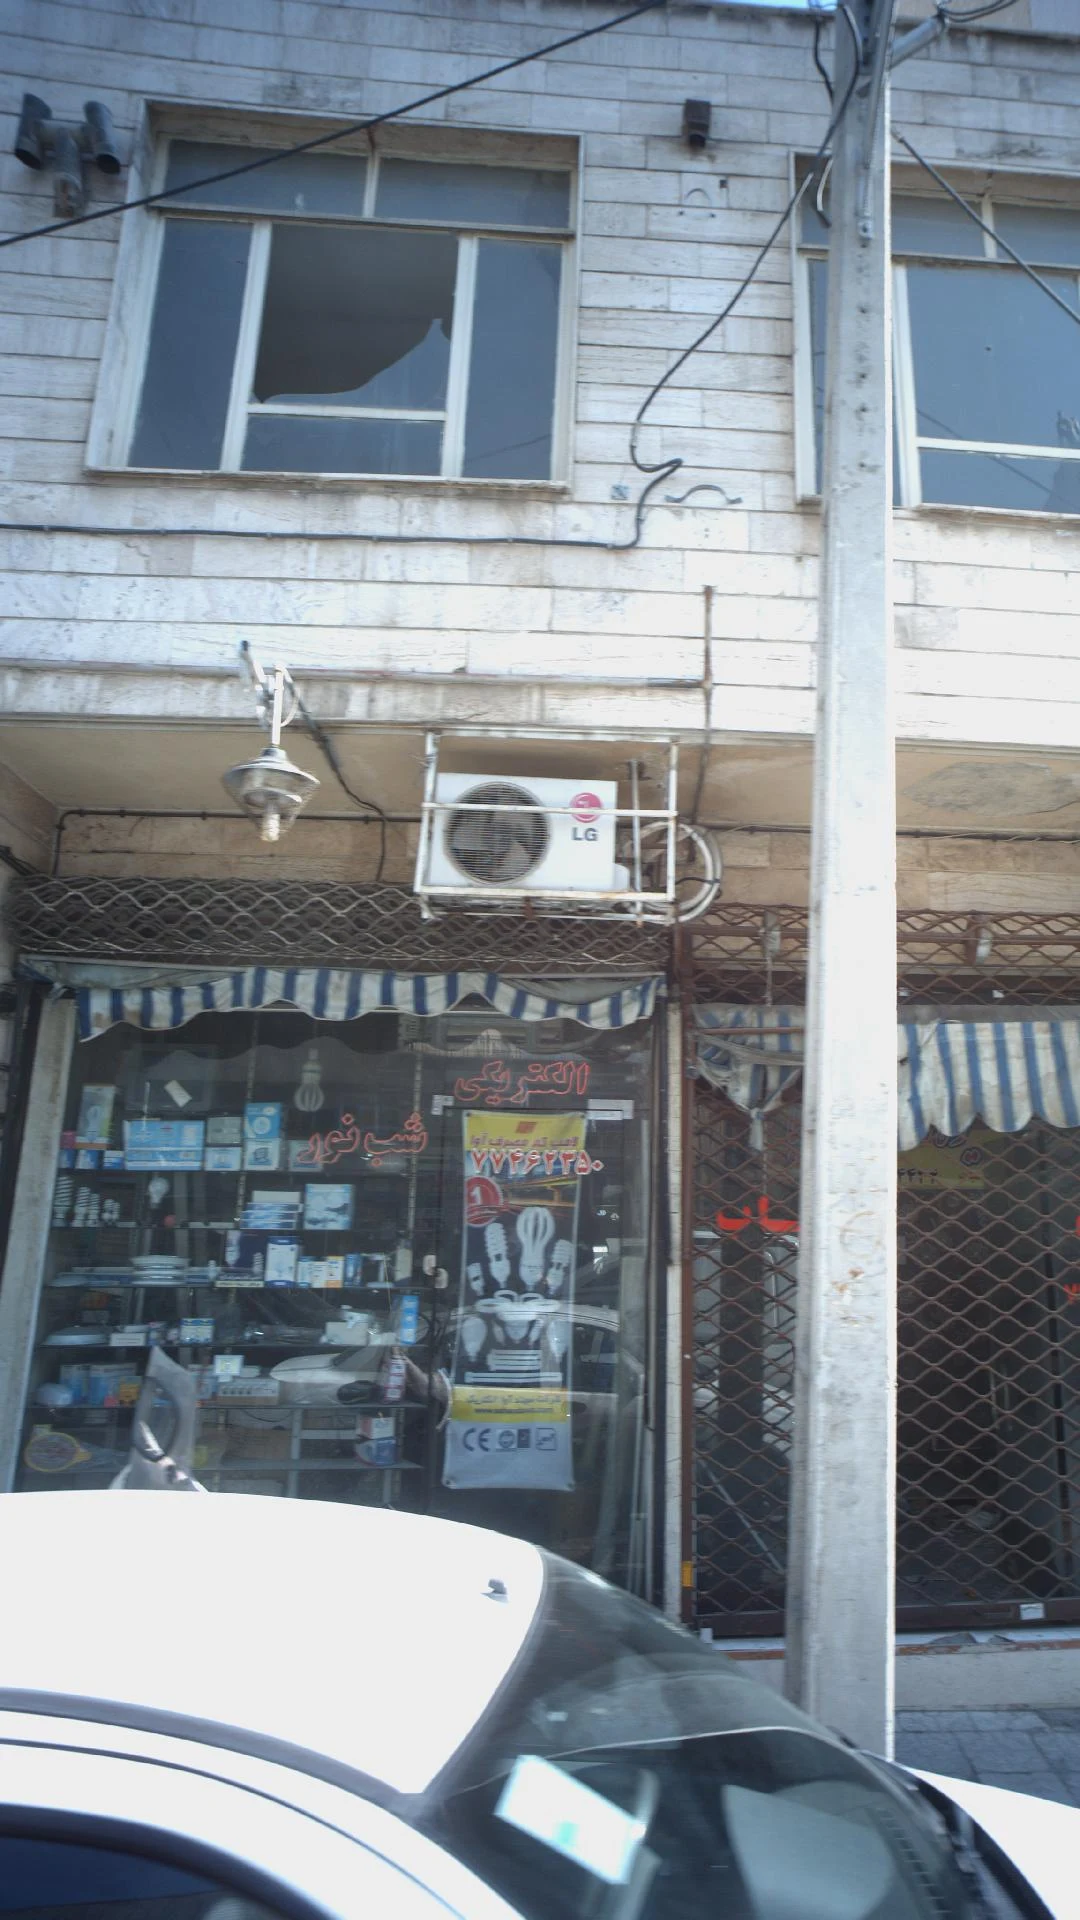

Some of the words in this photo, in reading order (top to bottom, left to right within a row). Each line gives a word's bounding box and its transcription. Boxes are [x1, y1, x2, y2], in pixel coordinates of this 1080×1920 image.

[572, 826, 599, 841] LG
[454, 1060, 591, 1104] الکتریکی
[363, 1112, 428, 1167] شب
